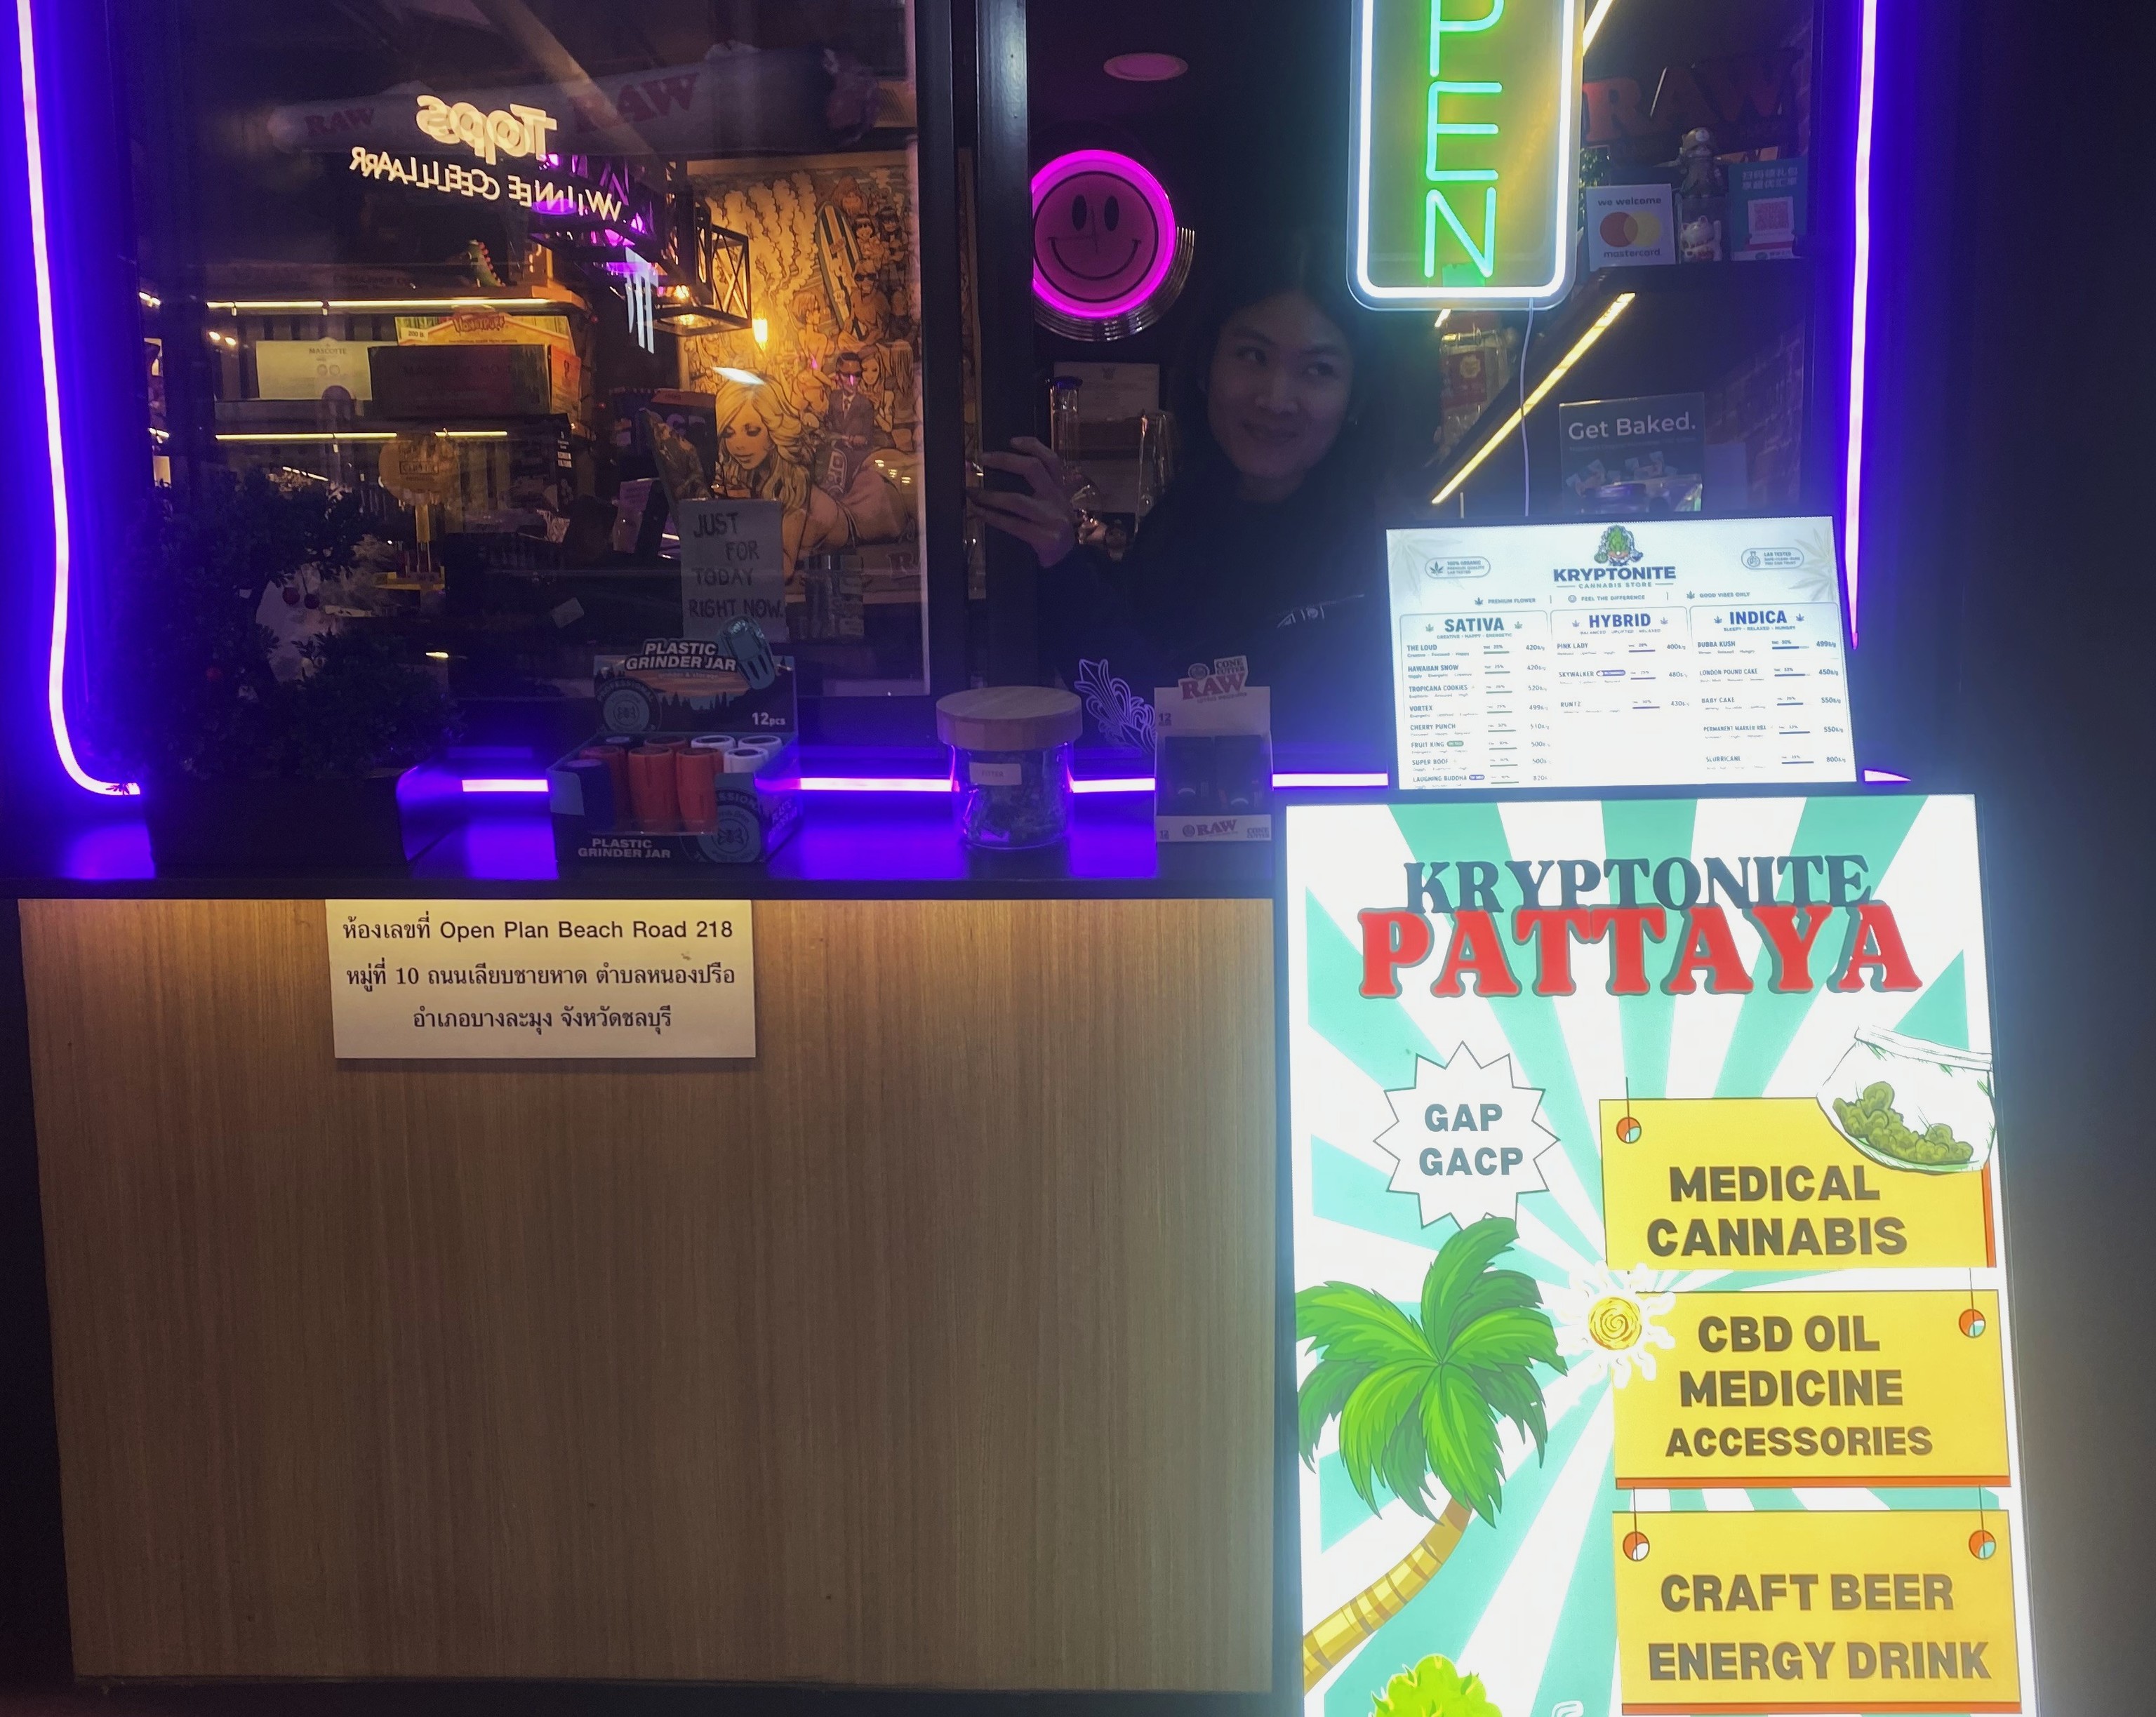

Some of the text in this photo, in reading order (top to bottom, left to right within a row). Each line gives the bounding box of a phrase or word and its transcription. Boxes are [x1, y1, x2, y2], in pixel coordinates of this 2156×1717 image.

[1583, 55, 1794, 142] RAW
[305, 107, 374, 137] RAW
[1616, 196, 1661, 206] welcome
[1604, 248, 1661, 258] mastercard
[1568, 411, 1696, 441] Get Baked.
[693, 512, 738, 538] JUST
[726, 540, 759, 561] FOR
[691, 568, 754, 586] TODAY
[1553, 566, 1677, 582] KRYPTONITE
[688, 599, 736, 618] RIGHT
[1589, 613, 1651, 629] HYBRID
[1729, 610, 1788, 625] INDICA
[1444, 617, 1505, 633] SATIVA
[645, 643, 717, 655] PLASTIC
[1216, 658, 1244, 667] CONE
[625, 656, 737, 671] GRINDER JAR
[1180, 672, 1245, 700] RAW
[752, 712, 786, 727] 12pcs
[1159, 713, 1171, 722] 12
[1196, 820, 1237, 836] RAW
[578, 848, 671, 859] GRINDER JAR
[592, 838, 653, 848] PLASTIC
[1404, 855, 1872, 914] KRYPTONITE
[343, 911, 733, 942] ห้องเลขที่ Open Plan Beach Road 218
[1357, 902, 1923, 997] PATTAYA
[347, 957, 736, 992] หมู่ที่ 10 ถนนเลียบชายหาด ตำบลหนองปรือ
[413, 1006, 672, 1035] อำเภอบางละมุง จังหวัดชลบุรี
[1423, 1104, 1503, 1133] GAP
[1418, 1147, 1524, 1176] GACP
[1670, 1165, 1880, 1203] MEDICAL
[1646, 1217, 1908, 1257] CANNABIS
[1697, 1314, 1881, 1353] CBD OIL
[1679, 1369, 1903, 1407] MEDICINE
[1665, 1426, 1933, 1458] ACCESSORIES
[1660, 1573, 1955, 1613] CRAFT BEER
[1648, 1641, 1992, 1682] ENERGY DRINK
